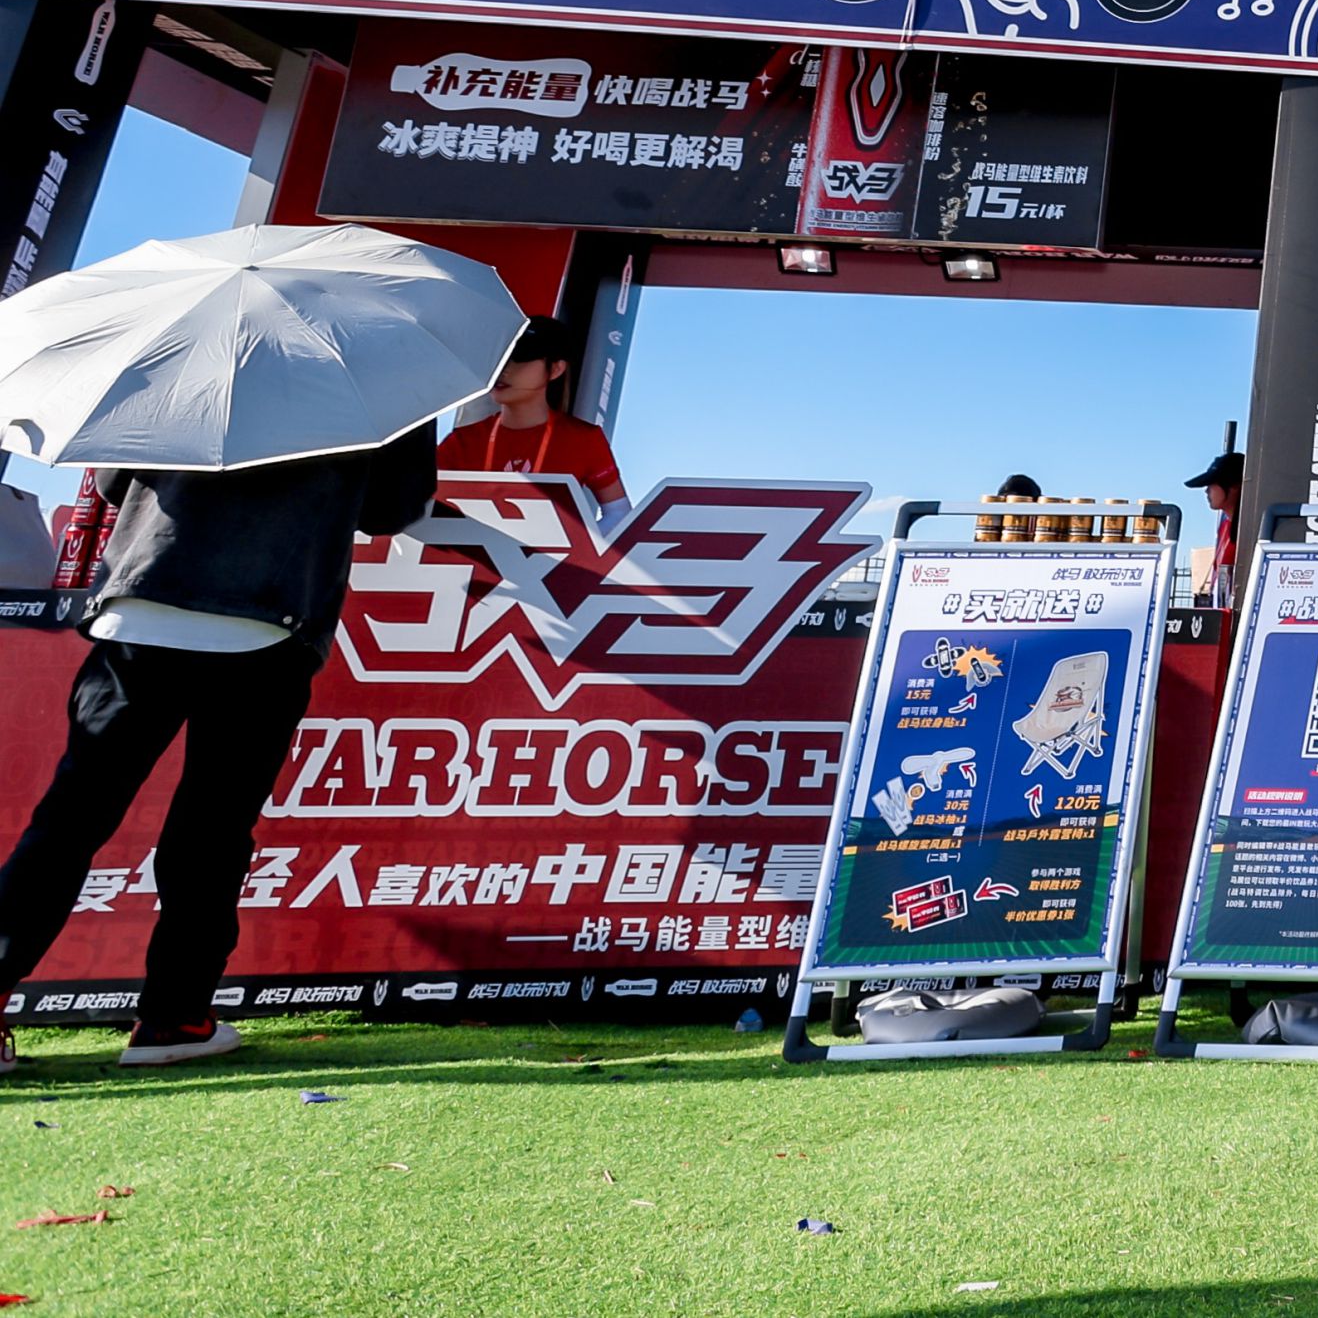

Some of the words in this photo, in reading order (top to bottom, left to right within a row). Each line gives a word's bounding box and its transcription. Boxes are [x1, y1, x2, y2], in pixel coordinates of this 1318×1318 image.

[422, 64, 581, 104] 补充能量
[594, 75, 749, 109] 快喝战马
[378, 120, 539, 163] 冰爽提神
[551, 128, 743, 170] 好喝更解渴
[971, 162, 1089, 185] 战马能量型维生素饮料
[965, 186, 1023, 220] 15
[1019, 203, 1067, 221] 元/杯
[475, 729, 845, 807] HORSE
[943, 800, 968, 810] 30元
[1054, 795, 1099, 810] 120元
[1059, 816, 1095, 826] 即可获得
[255, 988, 292, 1004] 战马
[290, 986, 363, 1002] 敢玩时刻
[668, 980, 700, 994] 战马
